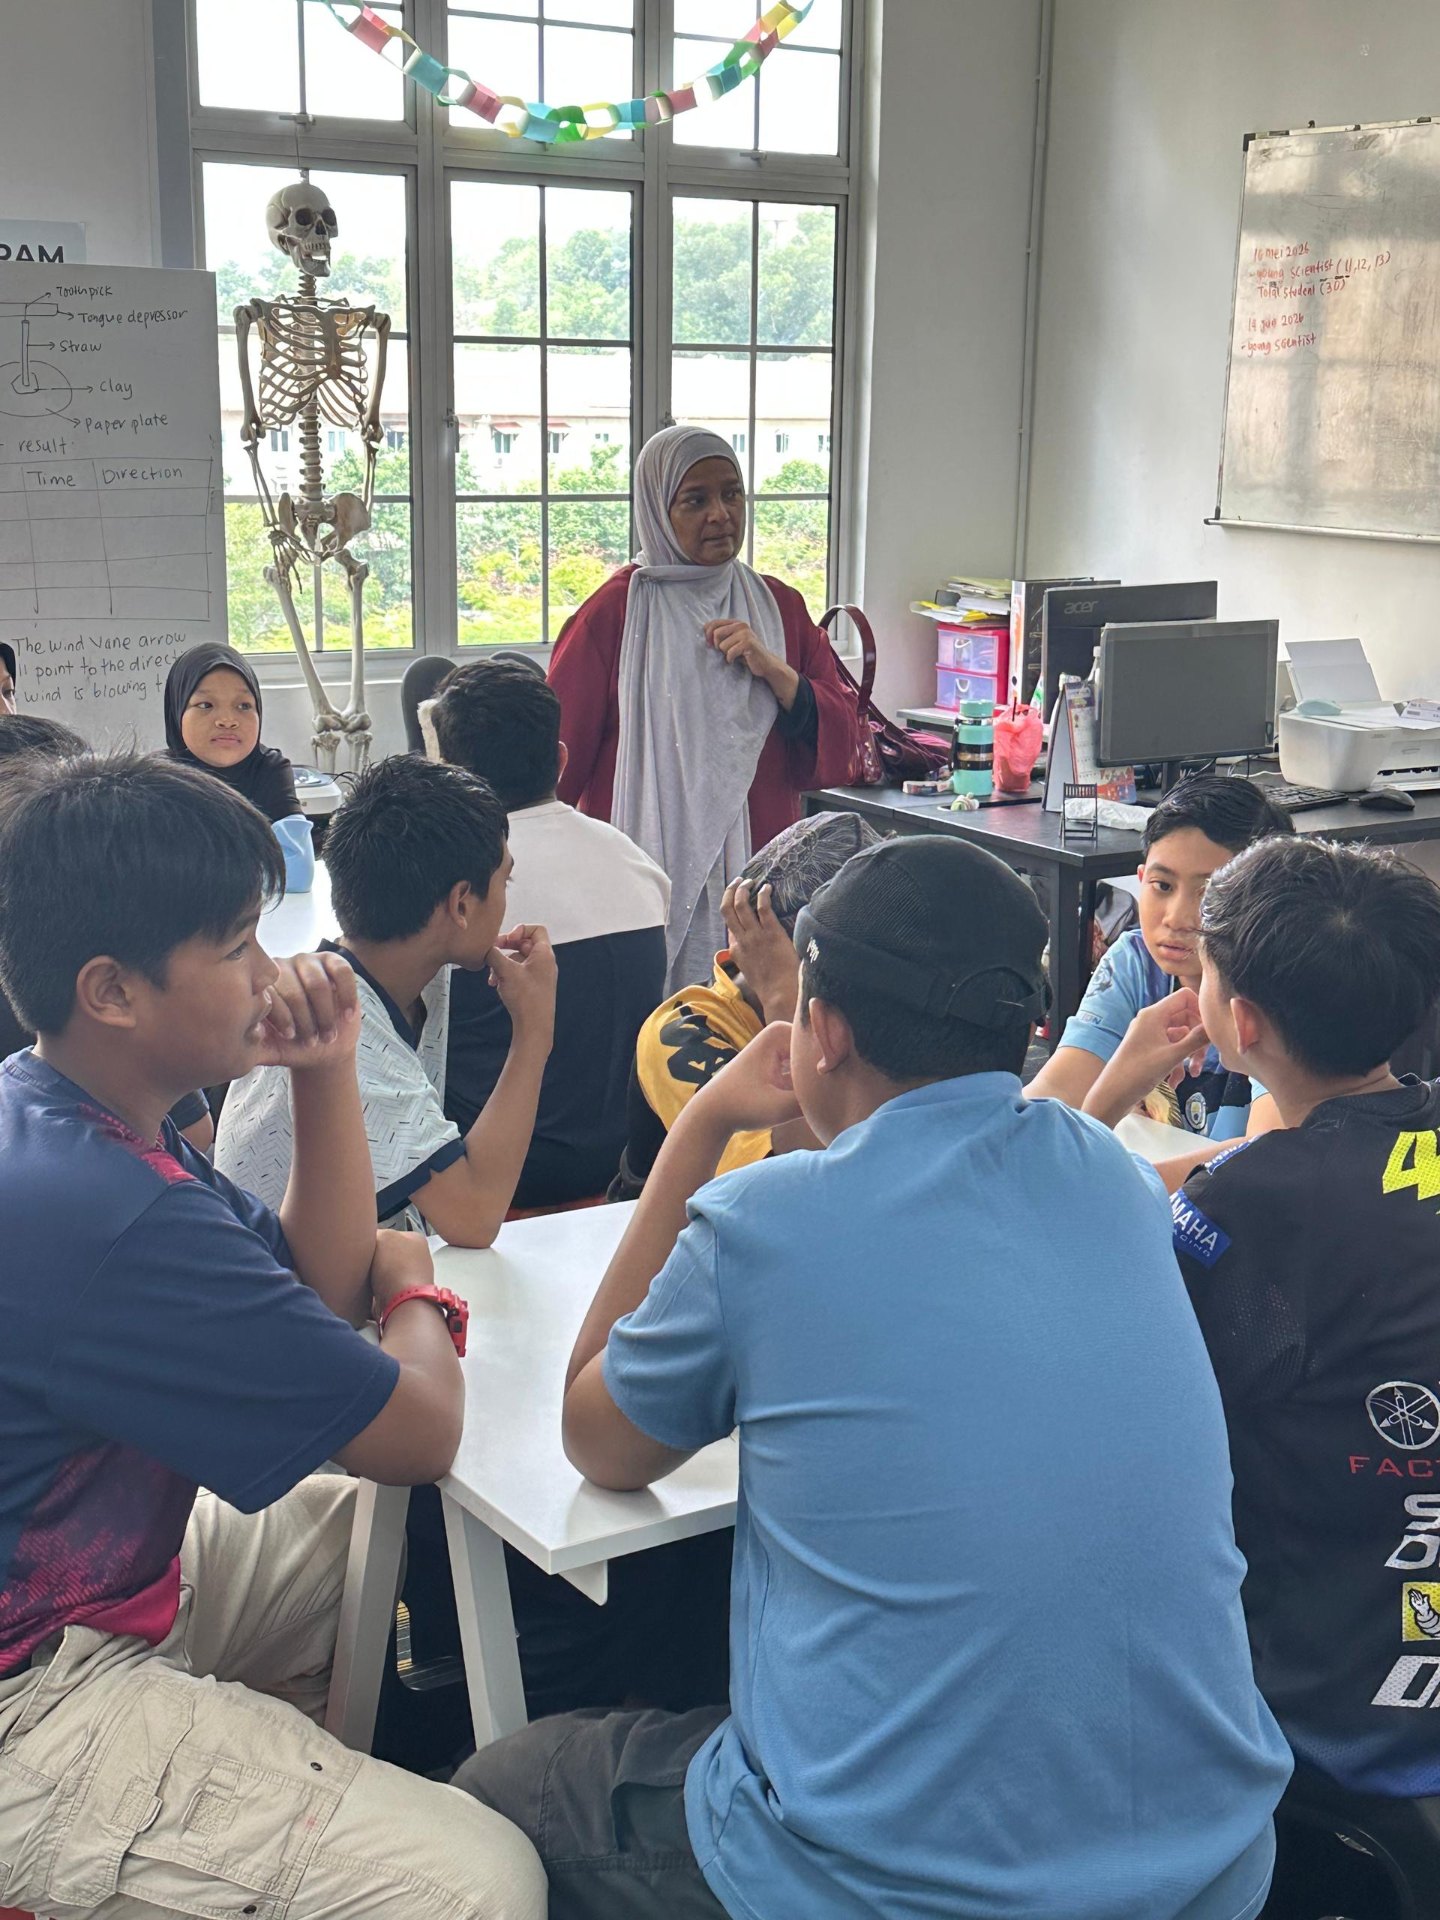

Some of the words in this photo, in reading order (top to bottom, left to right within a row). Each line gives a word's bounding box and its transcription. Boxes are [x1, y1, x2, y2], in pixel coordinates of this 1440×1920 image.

[78, 311, 123, 328] Tongue
[127, 309, 189, 329] depressor
[131, 412, 168, 435] plate
[26, 471, 76, 487] Time
[102, 466, 183, 485] Direction
[1064, 600, 1099, 614] acer
[11, 636, 45, 656] The
[139, 632, 186, 648] arrow
[35, 659, 74, 685] point
[80, 656, 97, 676] to
[101, 658, 125, 676] the
[74, 686, 84, 701] is
[93, 680, 147, 701] blowing
[1349, 1455, 1440, 1478] FAC
